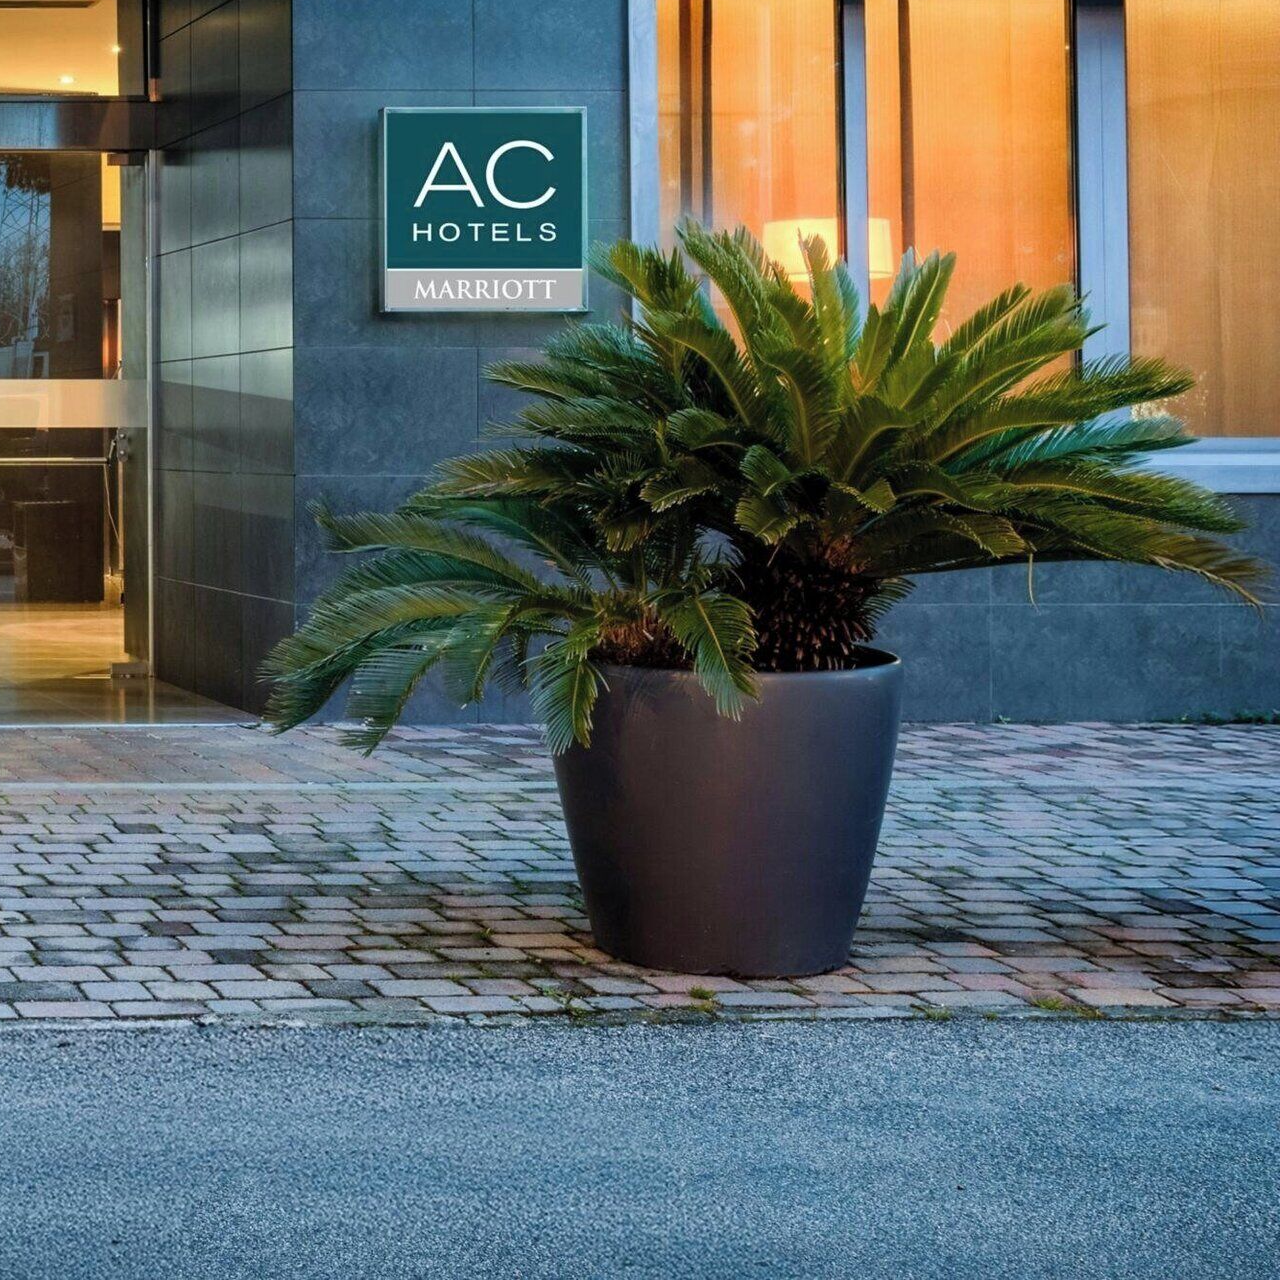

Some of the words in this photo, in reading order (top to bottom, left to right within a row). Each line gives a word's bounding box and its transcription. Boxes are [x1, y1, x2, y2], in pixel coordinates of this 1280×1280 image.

[413, 139, 557, 209] AC
[412, 222, 557, 242] HOTELS
[414, 279, 557, 300] MARRIOTT
